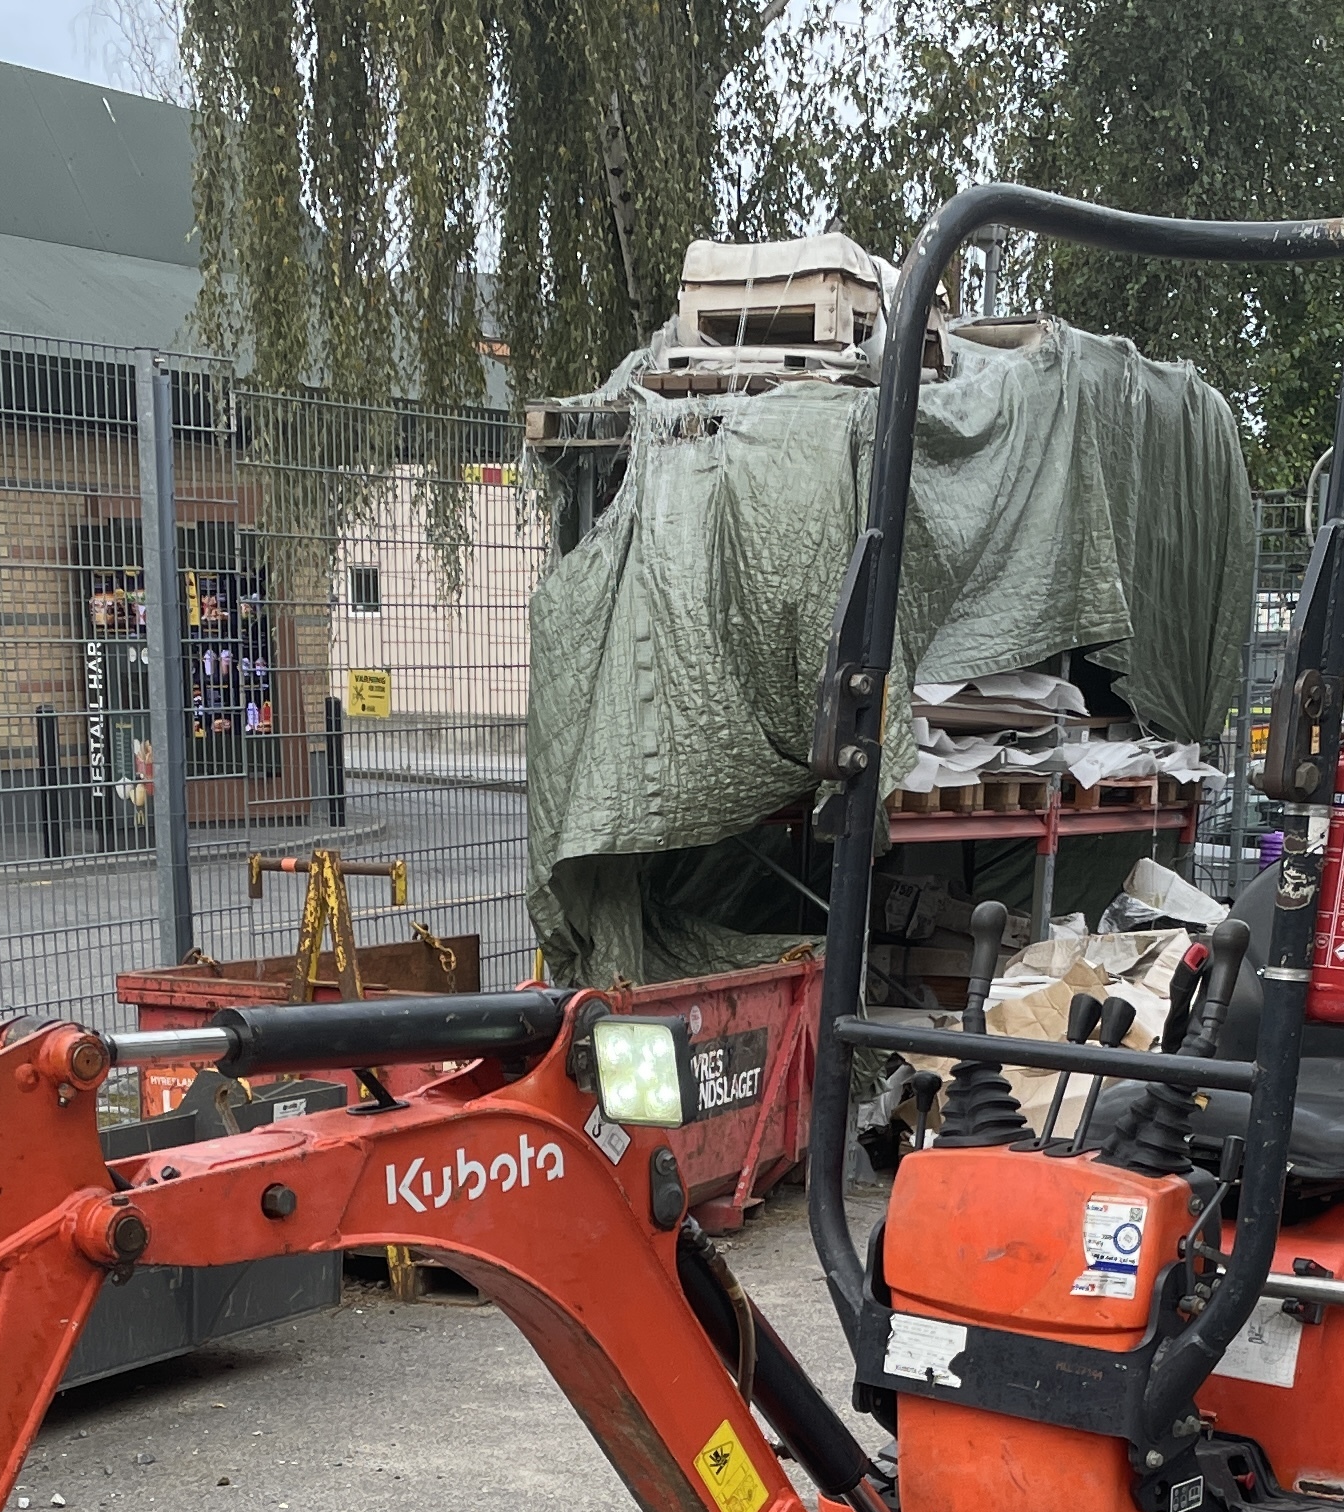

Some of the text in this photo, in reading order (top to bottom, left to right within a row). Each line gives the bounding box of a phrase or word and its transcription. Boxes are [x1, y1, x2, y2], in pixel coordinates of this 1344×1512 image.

[690, 1048, 724, 1082] YRES
[698, 1067, 761, 1111] NDSLAGET
[386, 1134, 565, 1213] Kubota
